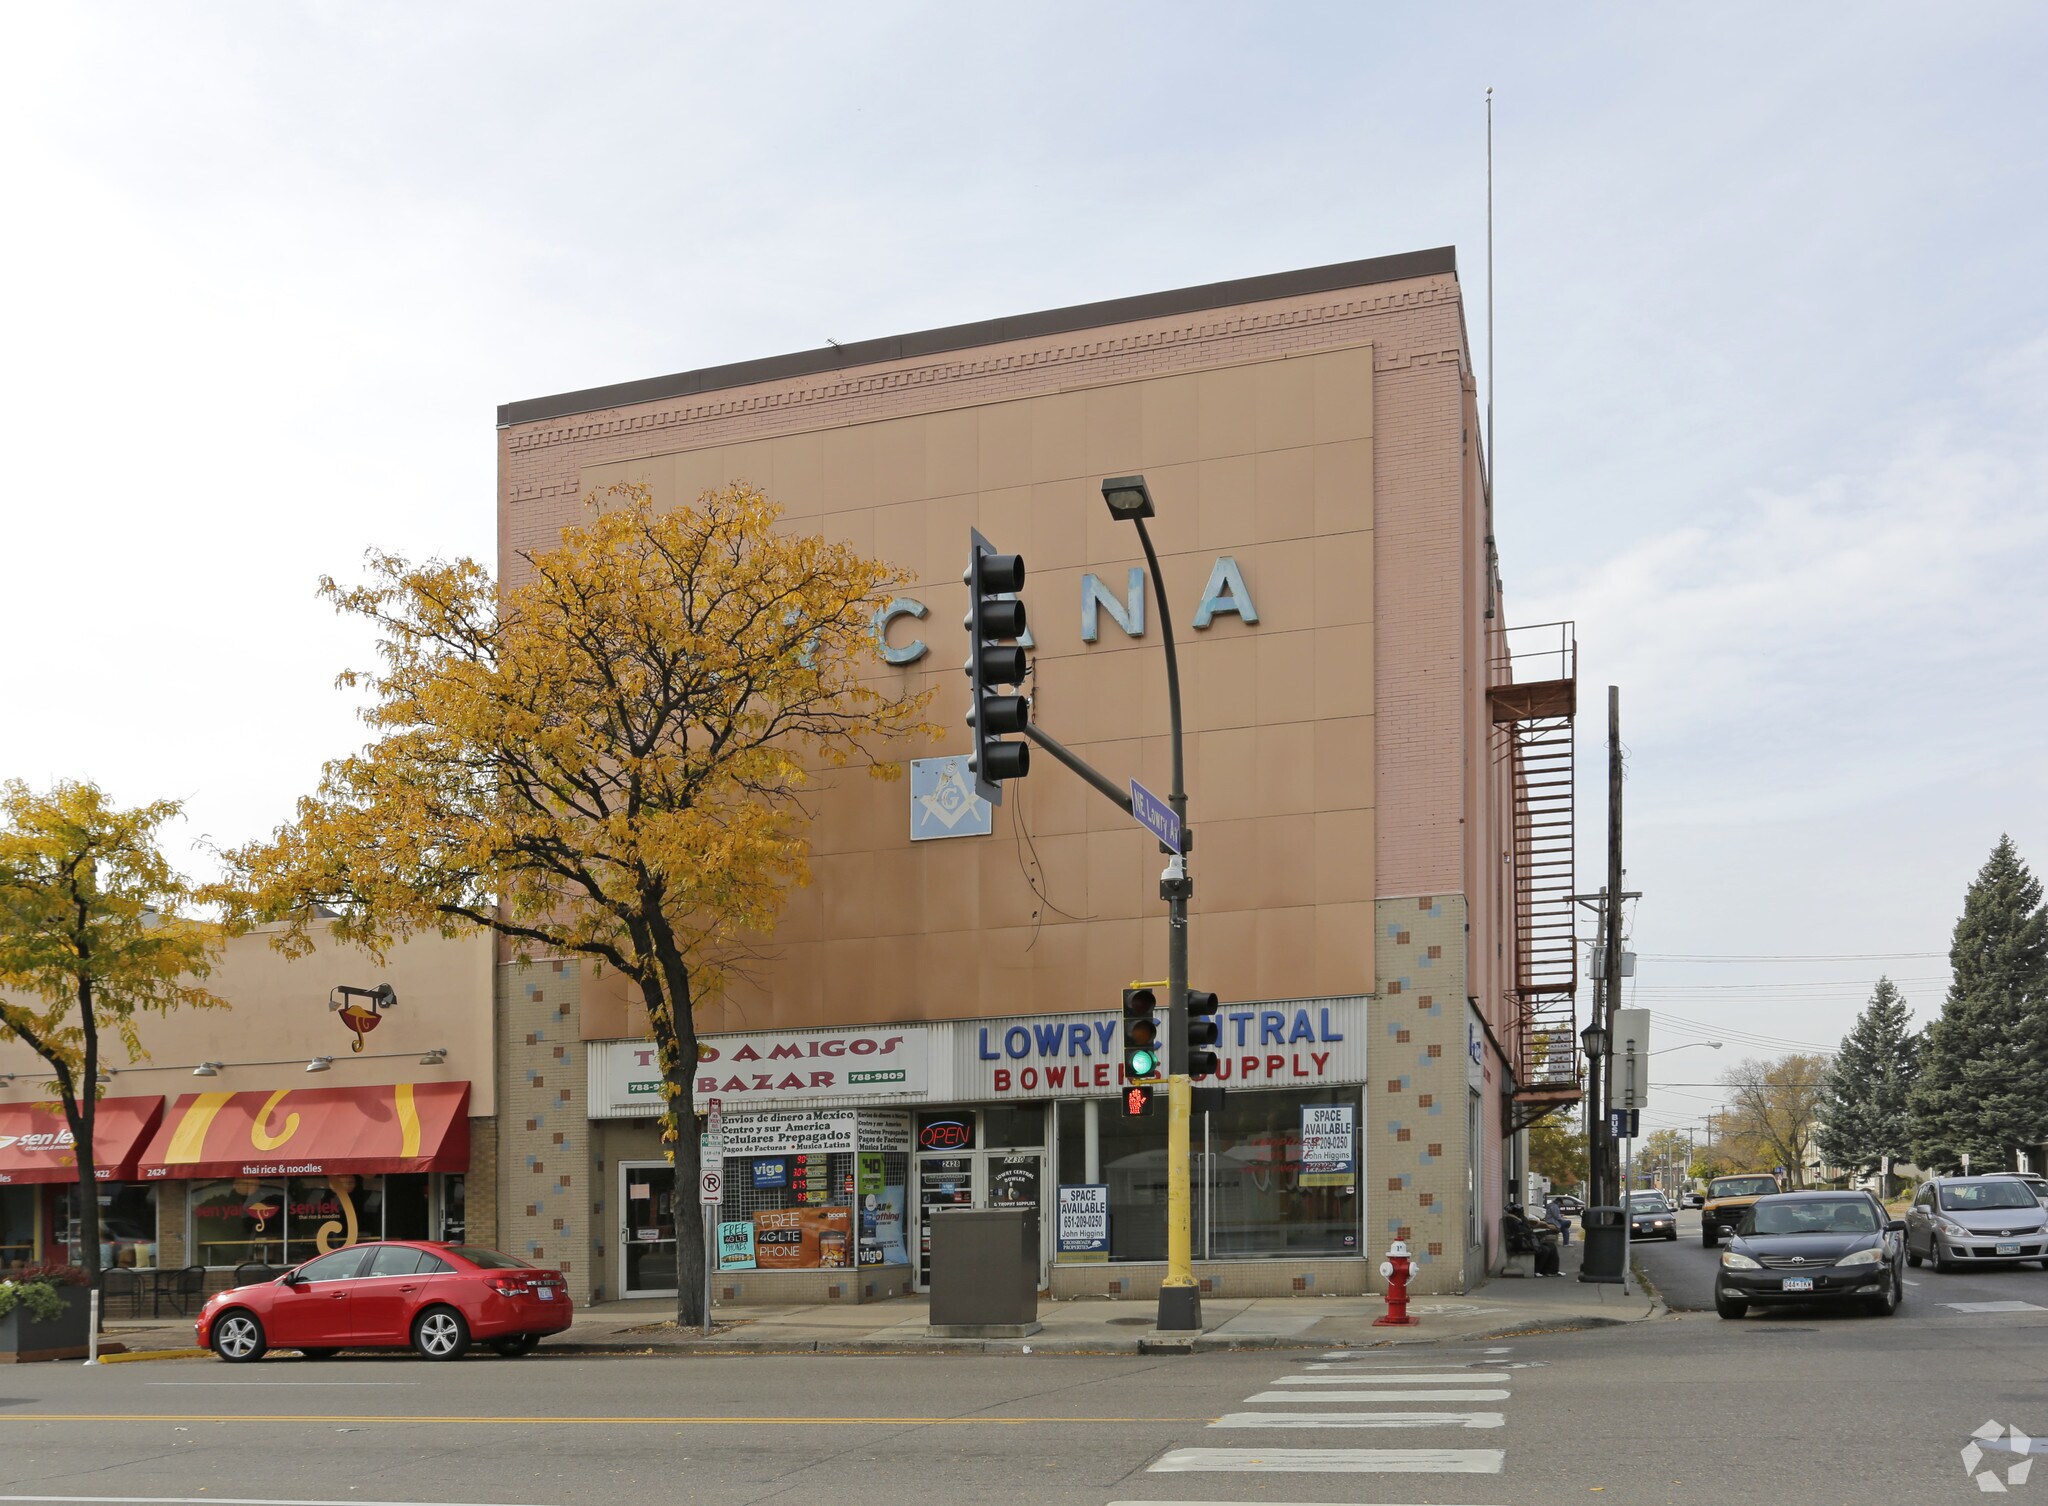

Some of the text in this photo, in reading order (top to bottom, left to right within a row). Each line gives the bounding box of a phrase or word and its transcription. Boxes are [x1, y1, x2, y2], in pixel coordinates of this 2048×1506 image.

[1134, 788, 1178, 844] NE Lowry Av
[979, 1020, 1116, 1060] LOWRY
[730, 1036, 904, 1062] AMIGOS
[1190, 1052, 1330, 1082] UPPLY
[696, 1071, 836, 1093] BAZAR
[850, 1072, 904, 1081] 788-9809
[722, 1115, 754, 1124] Envios
[757, 1113, 769, 1123] de
[770, 1113, 803, 1122] dinero
[1315, 1110, 1341, 1121] SPACE
[722, 1125, 754, 1134] Centro
[756, 1126, 763, 1134] y
[785, 1121, 831, 1132] America
[1305, 1122, 1351, 1135] AVAILABLE
[17, 1128, 75, 1146] sen le
[723, 1134, 774, 1145] Celulares
[778, 1130, 851, 1143] Prepagados
[858, 1135, 876, 1144] Pagos
[920, 1126, 970, 1145] OPEN
[823, 1141, 851, 1149] Latina
[1324, 1152, 1349, 1160] Higgins
[147, 1168, 167, 1177] 2424
[243, 1164, 322, 1174] thai rice & noodles
[754, 1162, 784, 1176] vigo
[995, 1169, 1034, 1181] LOWRY CENTRAL
[1071, 1190, 1096, 1201] SPACE
[290, 1199, 340, 1215] sen lek
[1062, 1202, 1105, 1214] AVAILABLE
[760, 1212, 800, 1228] FREE
[1064, 1215, 1103, 1228] 651-209-0250
[723, 1223, 748, 1235] FREE
[1080, 1230, 1104, 1238] Higgins
[760, 1231, 800, 1242] 4G LTE
[725, 1243, 747, 1252] PHONES
[760, 1245, 800, 1257] PHONE
[860, 1248, 883, 1263] vigo
